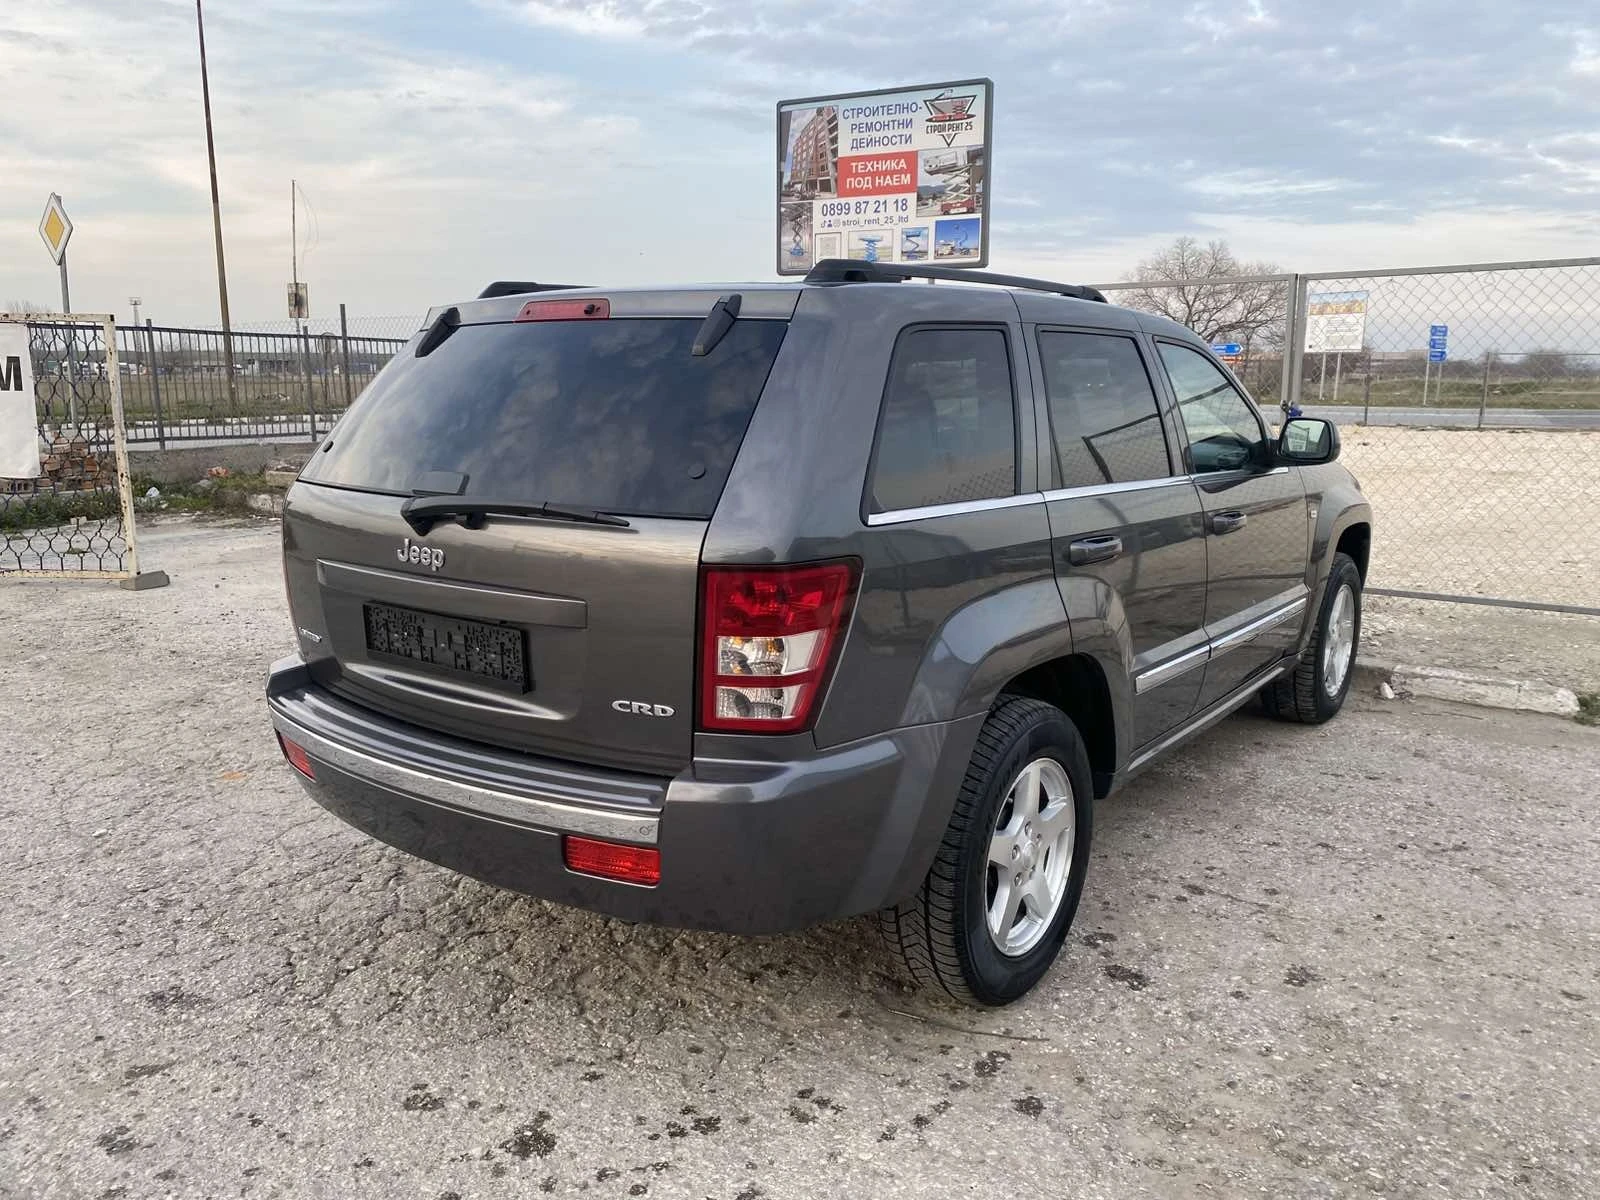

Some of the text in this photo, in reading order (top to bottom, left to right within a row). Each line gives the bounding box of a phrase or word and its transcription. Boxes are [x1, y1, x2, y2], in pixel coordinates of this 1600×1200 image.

[842, 101, 922, 120] СТРОИТЕЛНО-
[850, 118, 913, 134] РЕМОНТНИ
[948, 122, 964, 132] РЕНТ
[965, 121, 973, 131] 25
[850, 134, 913, 151] ДЕЙНОСТИ
[850, 158, 907, 174] ТЕХНИКА
[846, 174, 911, 190] ПОД НАЕМ
[821, 198, 908, 217] 0899 87 21 18
[396, 538, 445, 571] Jeep
[610, 699, 676, 718] CRD
